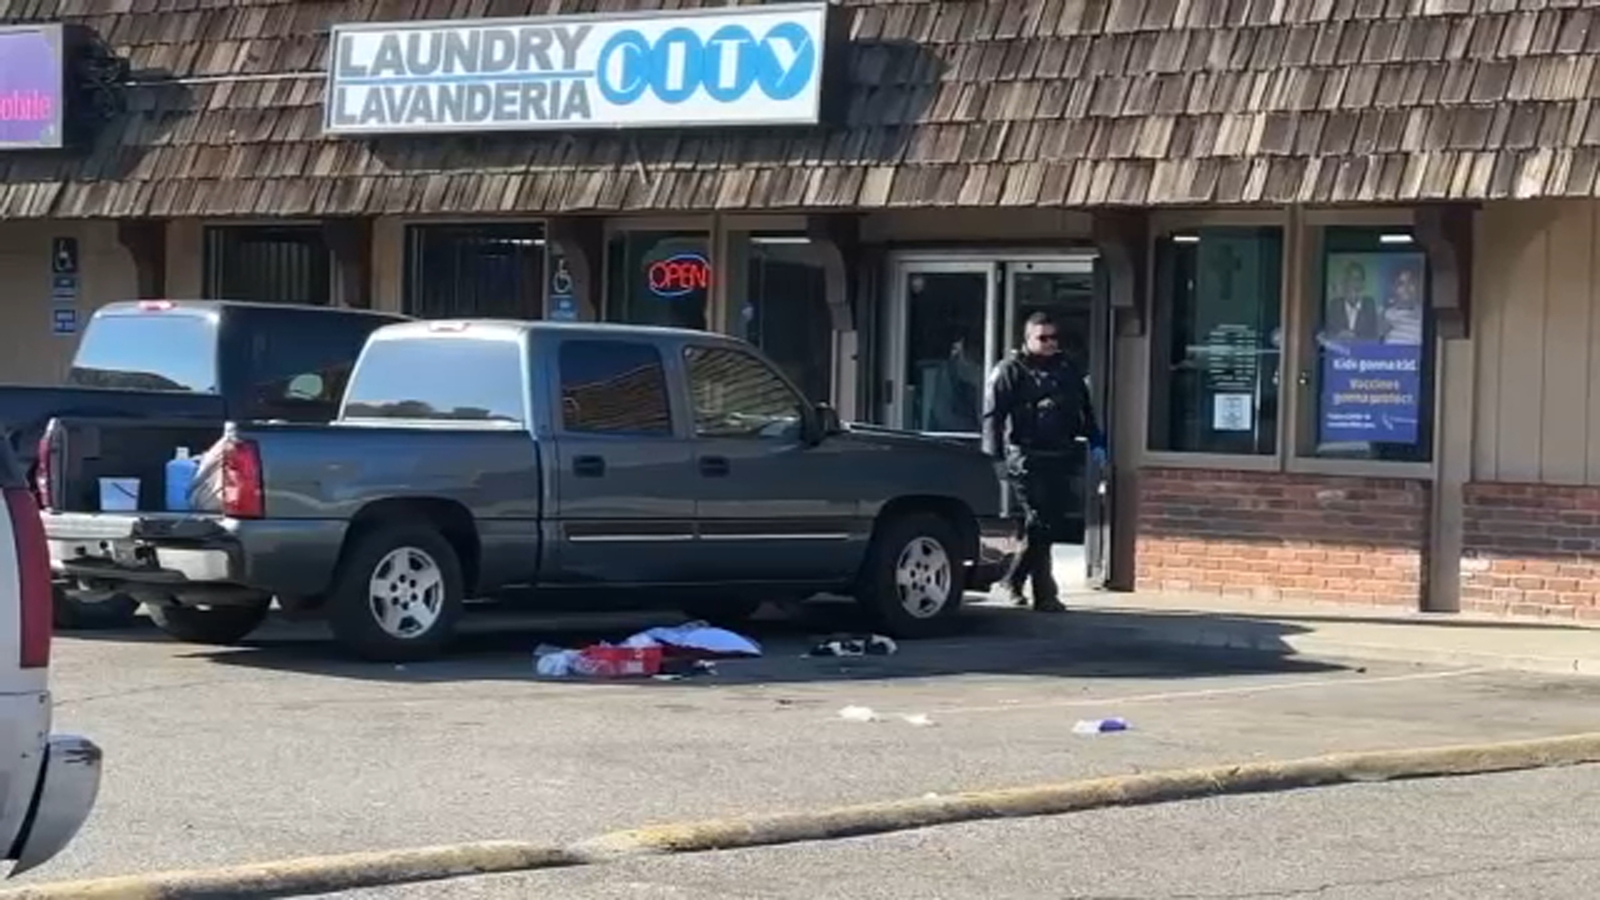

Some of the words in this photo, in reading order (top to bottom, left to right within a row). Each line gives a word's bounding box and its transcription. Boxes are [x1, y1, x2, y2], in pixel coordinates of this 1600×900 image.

[339, 25, 593, 78] LAUNDRY
[601, 27, 812, 101] CITY
[335, 79, 592, 125] LAVANDERIA
[650, 262, 709, 288] OPEN
